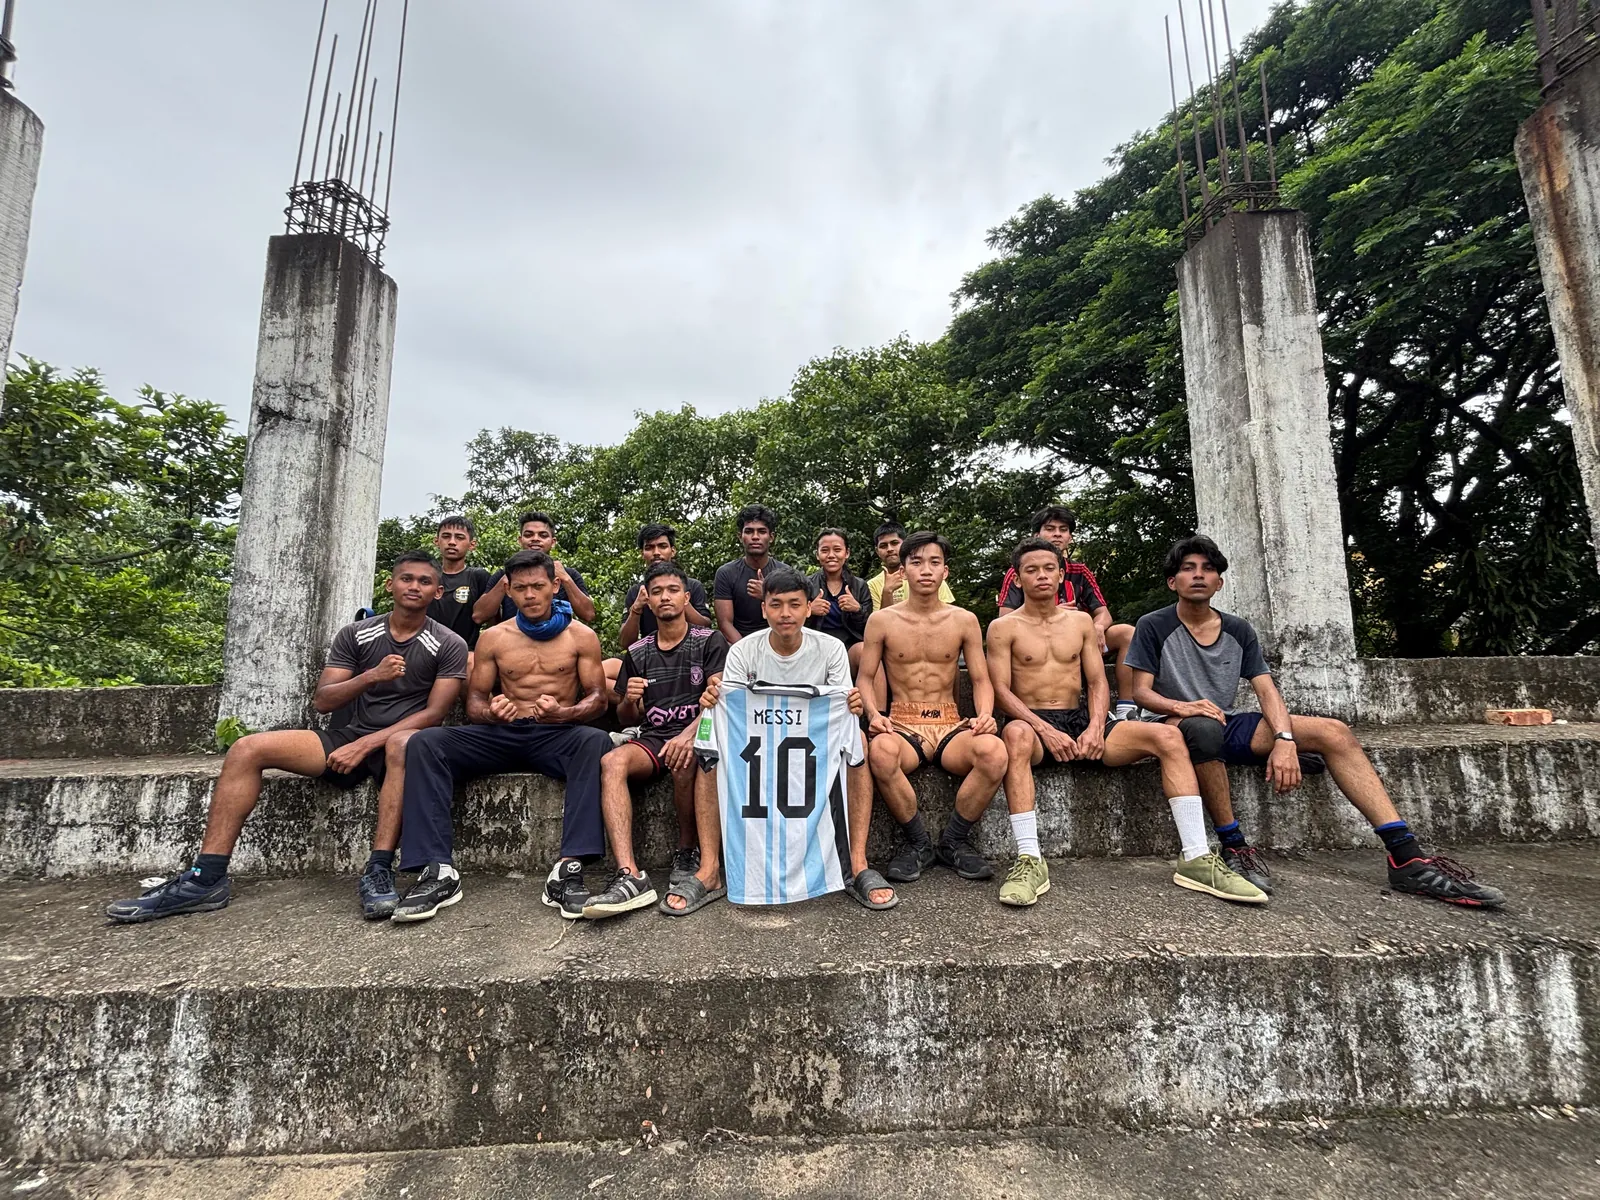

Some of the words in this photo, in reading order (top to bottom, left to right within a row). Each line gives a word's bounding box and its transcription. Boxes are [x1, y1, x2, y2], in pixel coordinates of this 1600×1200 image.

[667, 704, 699, 722] XBT
[754, 709, 802, 725] MESSI
[740, 736, 816, 818] 10
